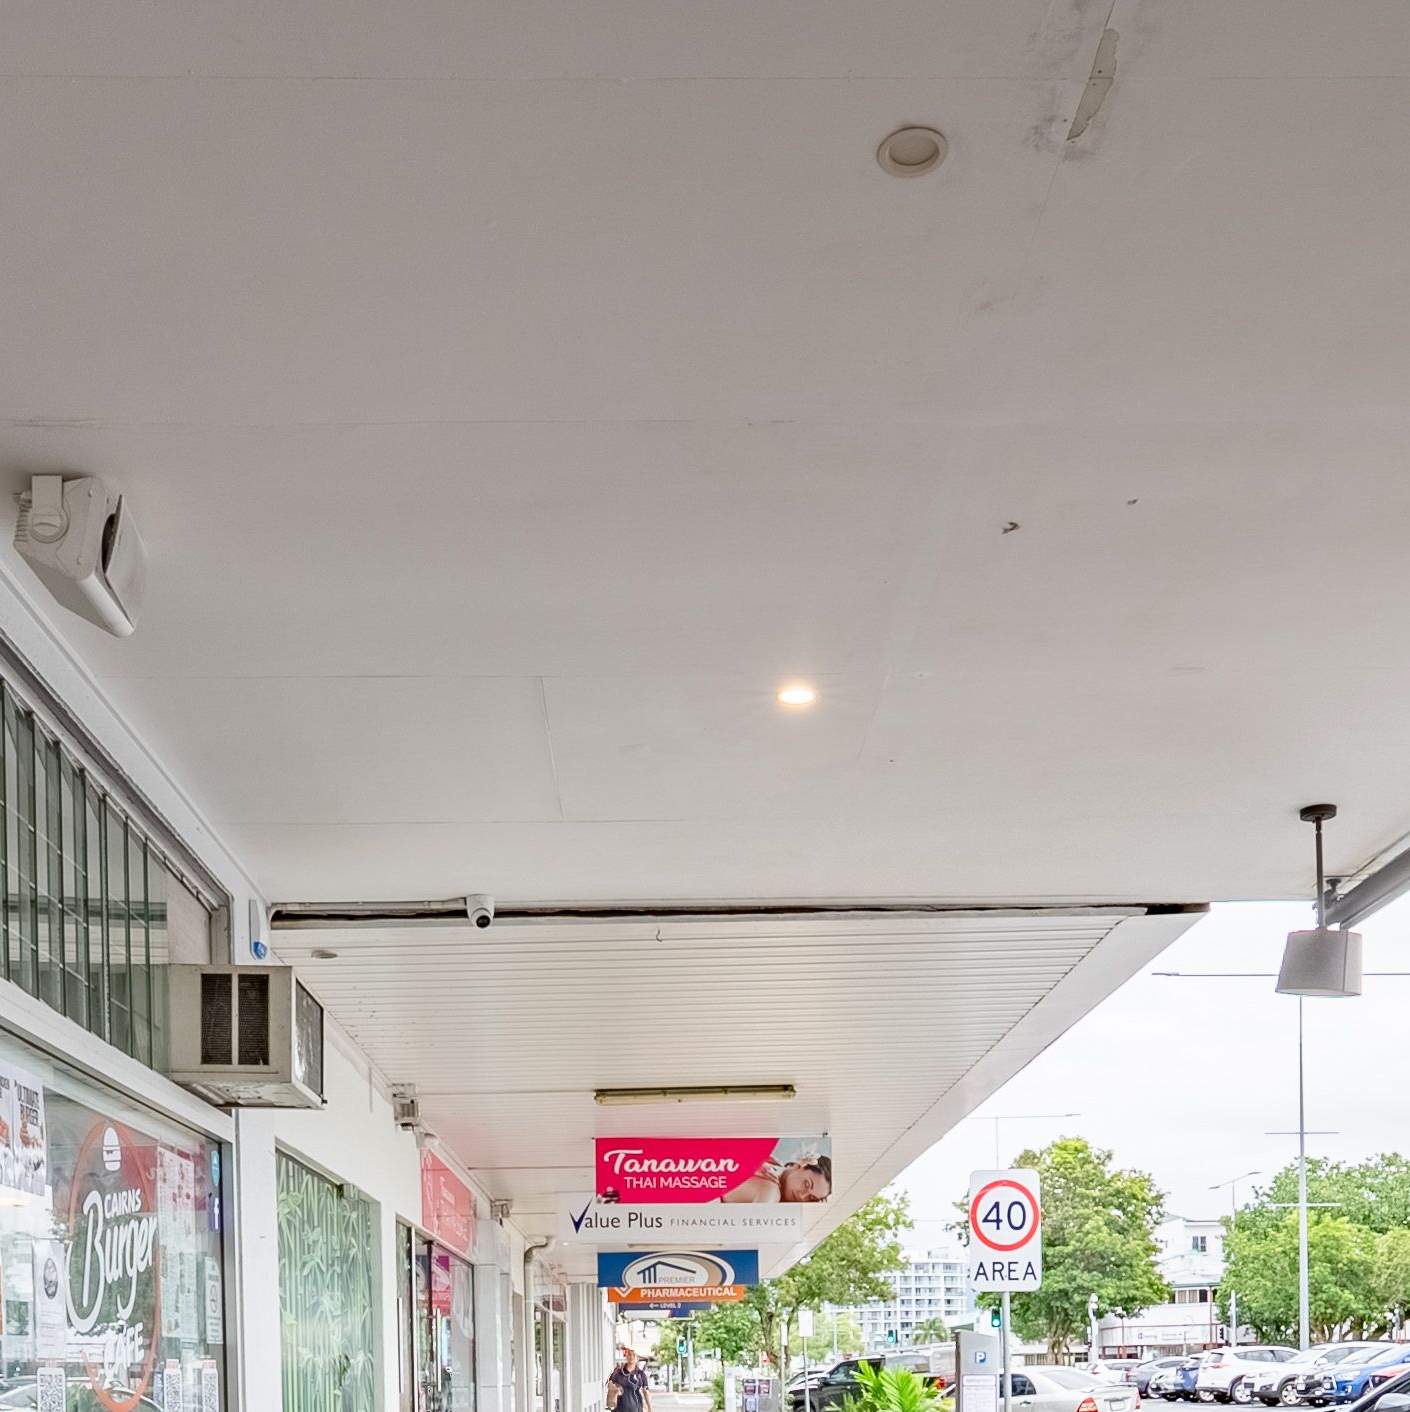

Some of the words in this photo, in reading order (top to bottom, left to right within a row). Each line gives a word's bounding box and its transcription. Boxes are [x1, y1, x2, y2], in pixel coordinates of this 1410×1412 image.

[603, 1148, 740, 1175] Tanawan
[623, 1176, 657, 1189] THAI
[659, 1176, 728, 1189] MASSAGE
[104, 1188, 141, 1219] CAIRNS
[569, 1197, 621, 1234] Value
[628, 1211, 663, 1229] Plus
[670, 1218, 736, 1227] FINANCIAL
[742, 1217, 797, 1227] SERVICES
[982, 1201, 1026, 1231] 40
[65, 1190, 158, 1334] Burger
[973, 1261, 1037, 1281] AREA
[640, 1287, 737, 1298] PHARMACEUTICAL
[658, 1276, 696, 1284] PREMIER
[104, 1322, 145, 1374] CAFE
